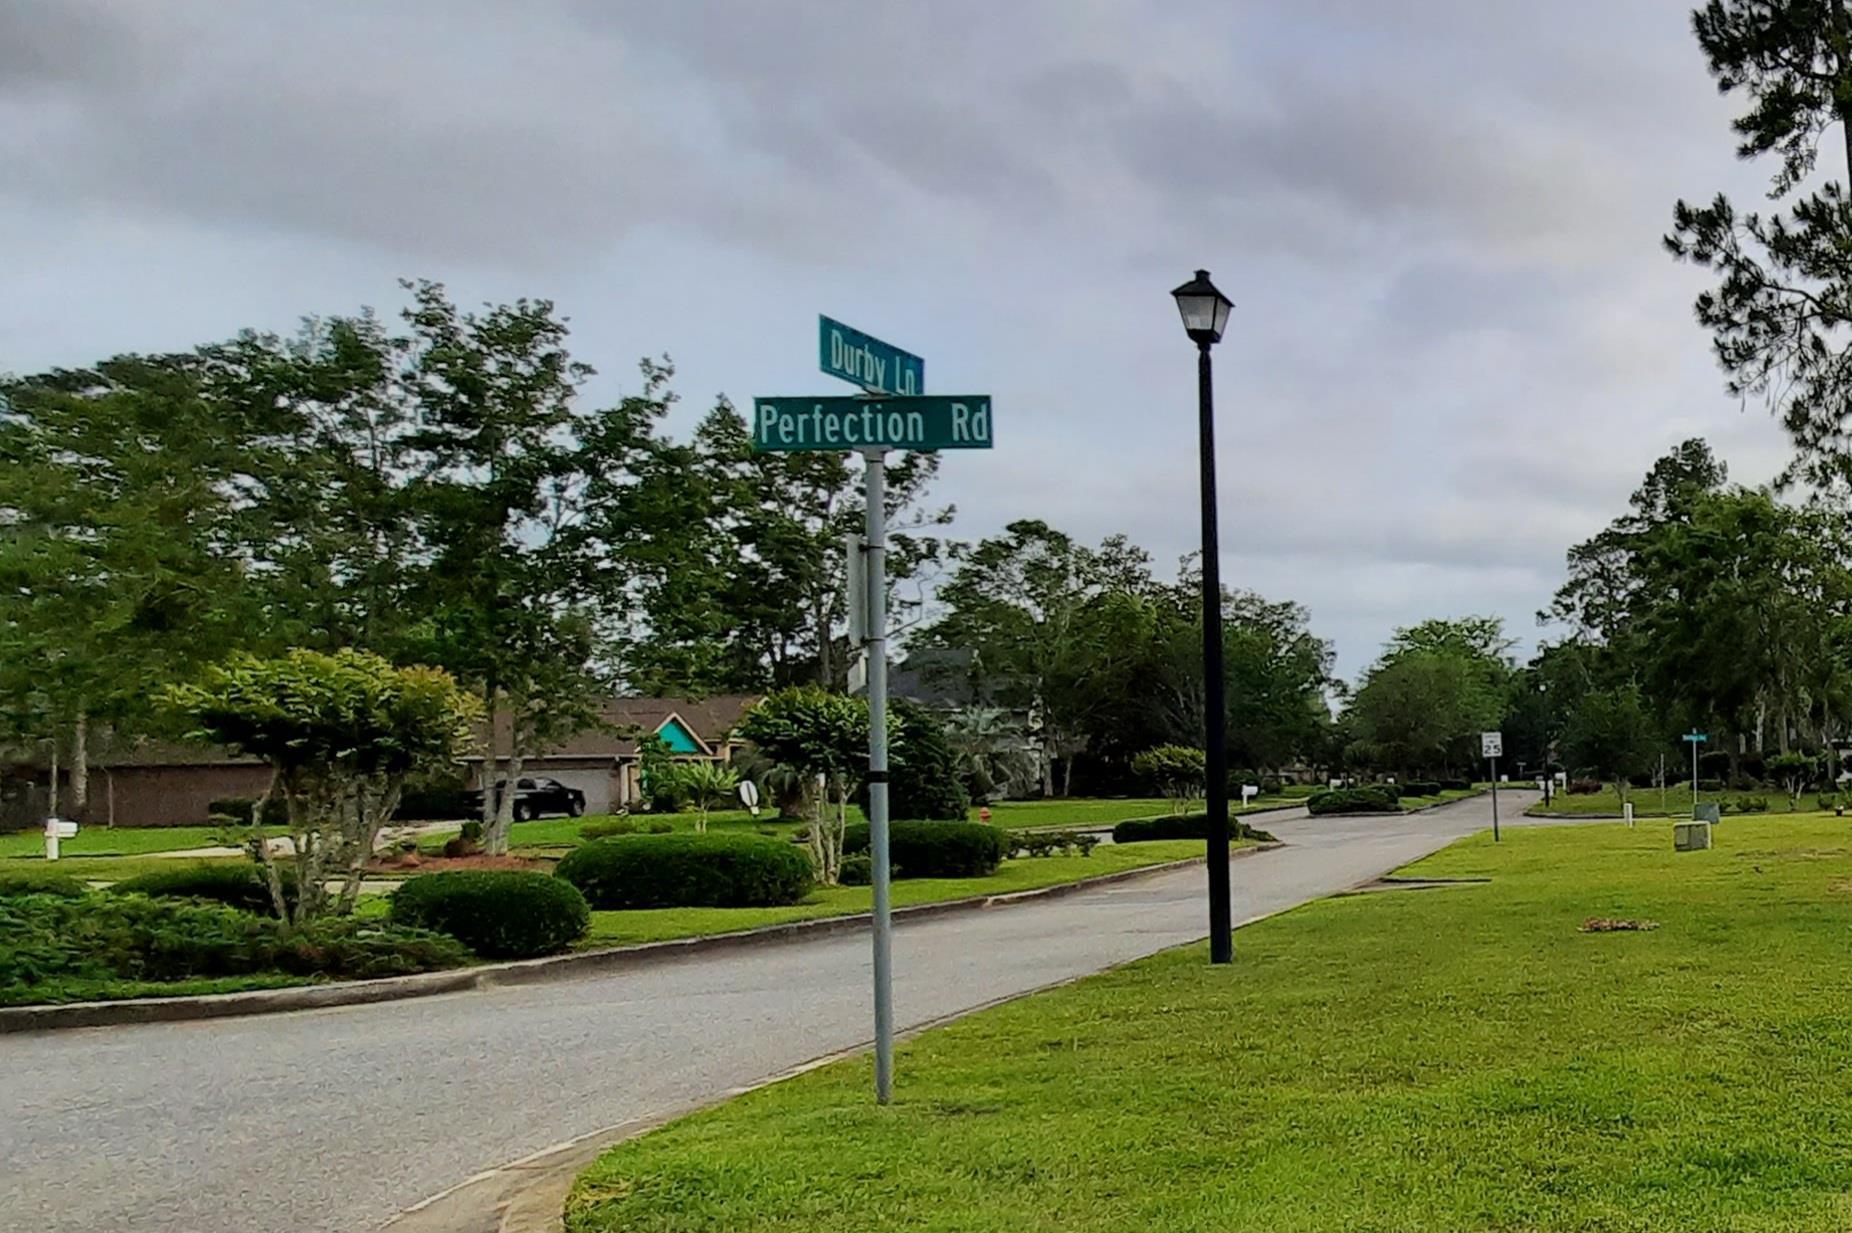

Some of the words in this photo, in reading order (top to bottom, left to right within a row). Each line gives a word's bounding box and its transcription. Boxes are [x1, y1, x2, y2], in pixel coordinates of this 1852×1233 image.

[831, 329, 886, 389] Durby
[895, 356, 916, 395] Ln
[760, 404, 924, 443] Perfection
[951, 403, 988, 441] Rd
[1484, 744, 1501, 754] 25
